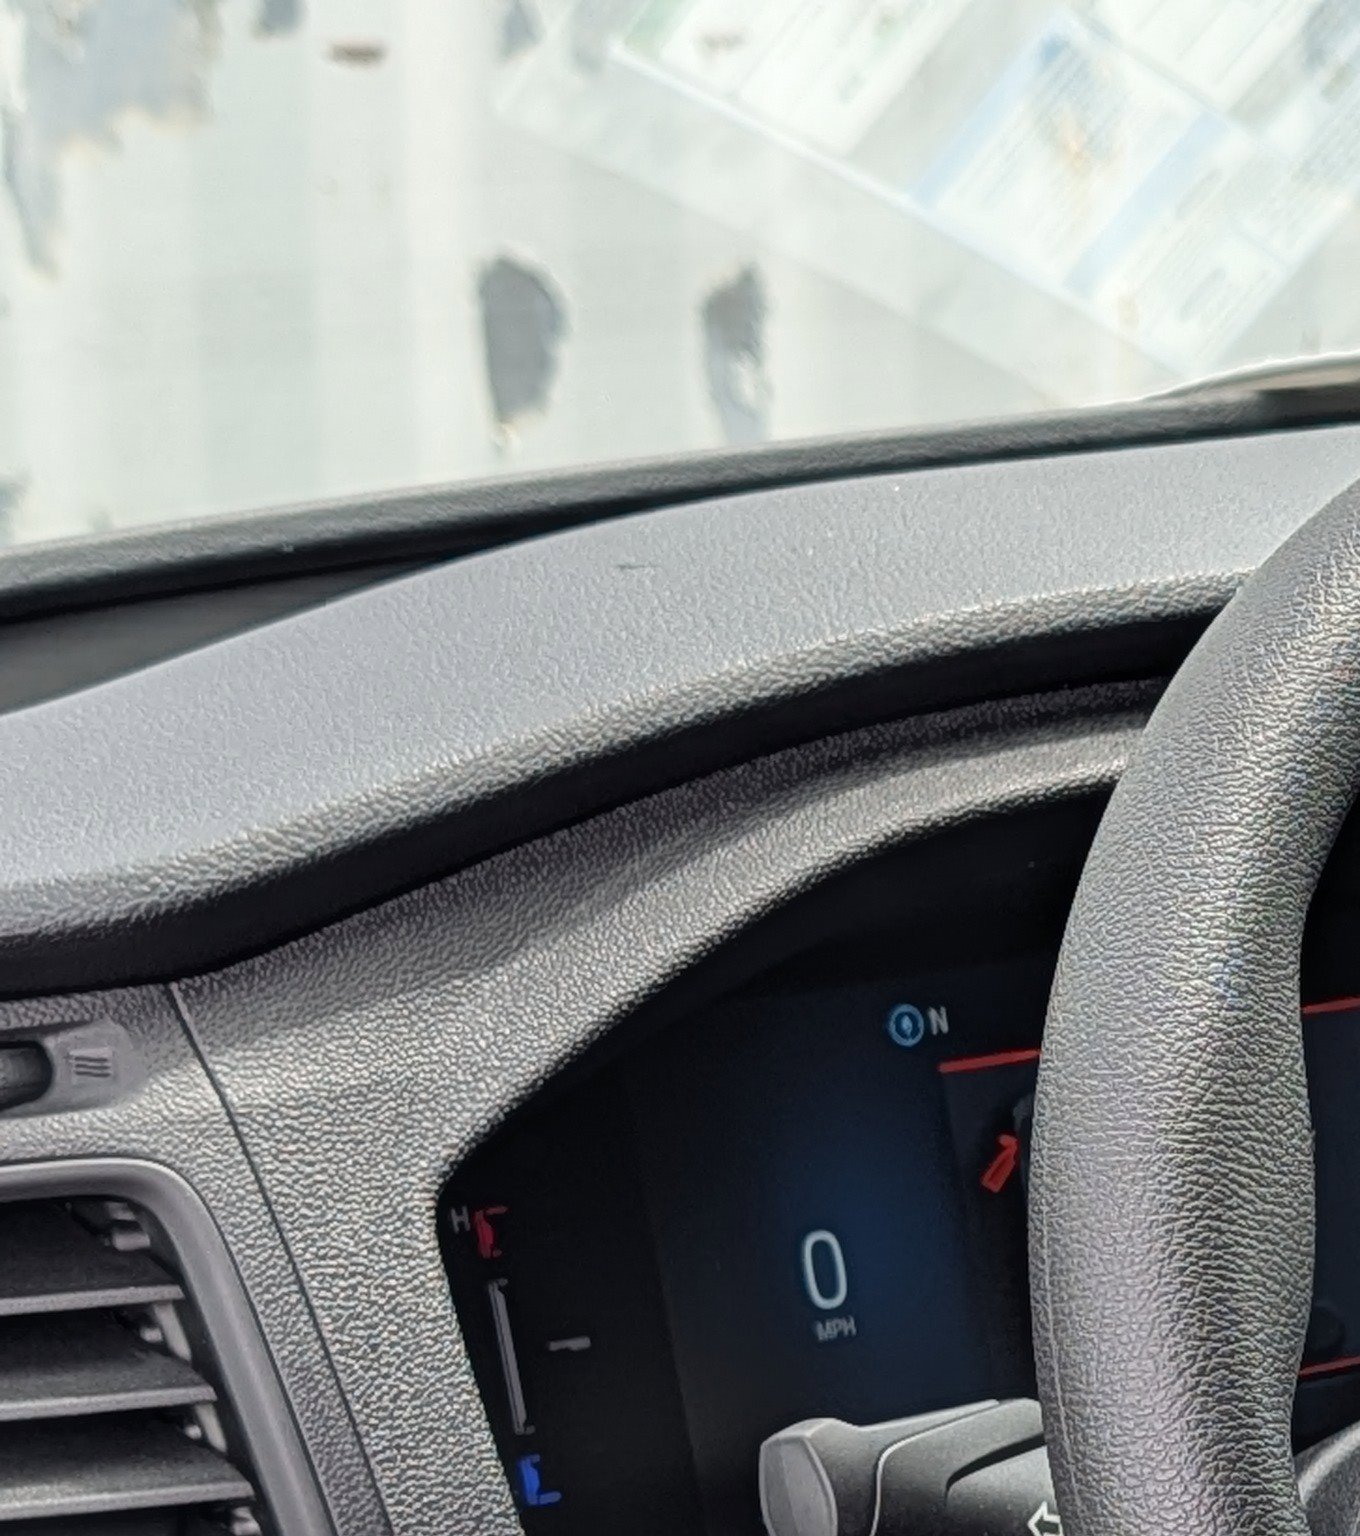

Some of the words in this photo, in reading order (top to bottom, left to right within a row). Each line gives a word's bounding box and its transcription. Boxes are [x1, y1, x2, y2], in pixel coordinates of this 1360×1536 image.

[928, 1006, 949, 1035] N
[450, 1206, 471, 1233] H
[803, 1229, 848, 1310] 0
[815, 1315, 857, 1342] MPH
